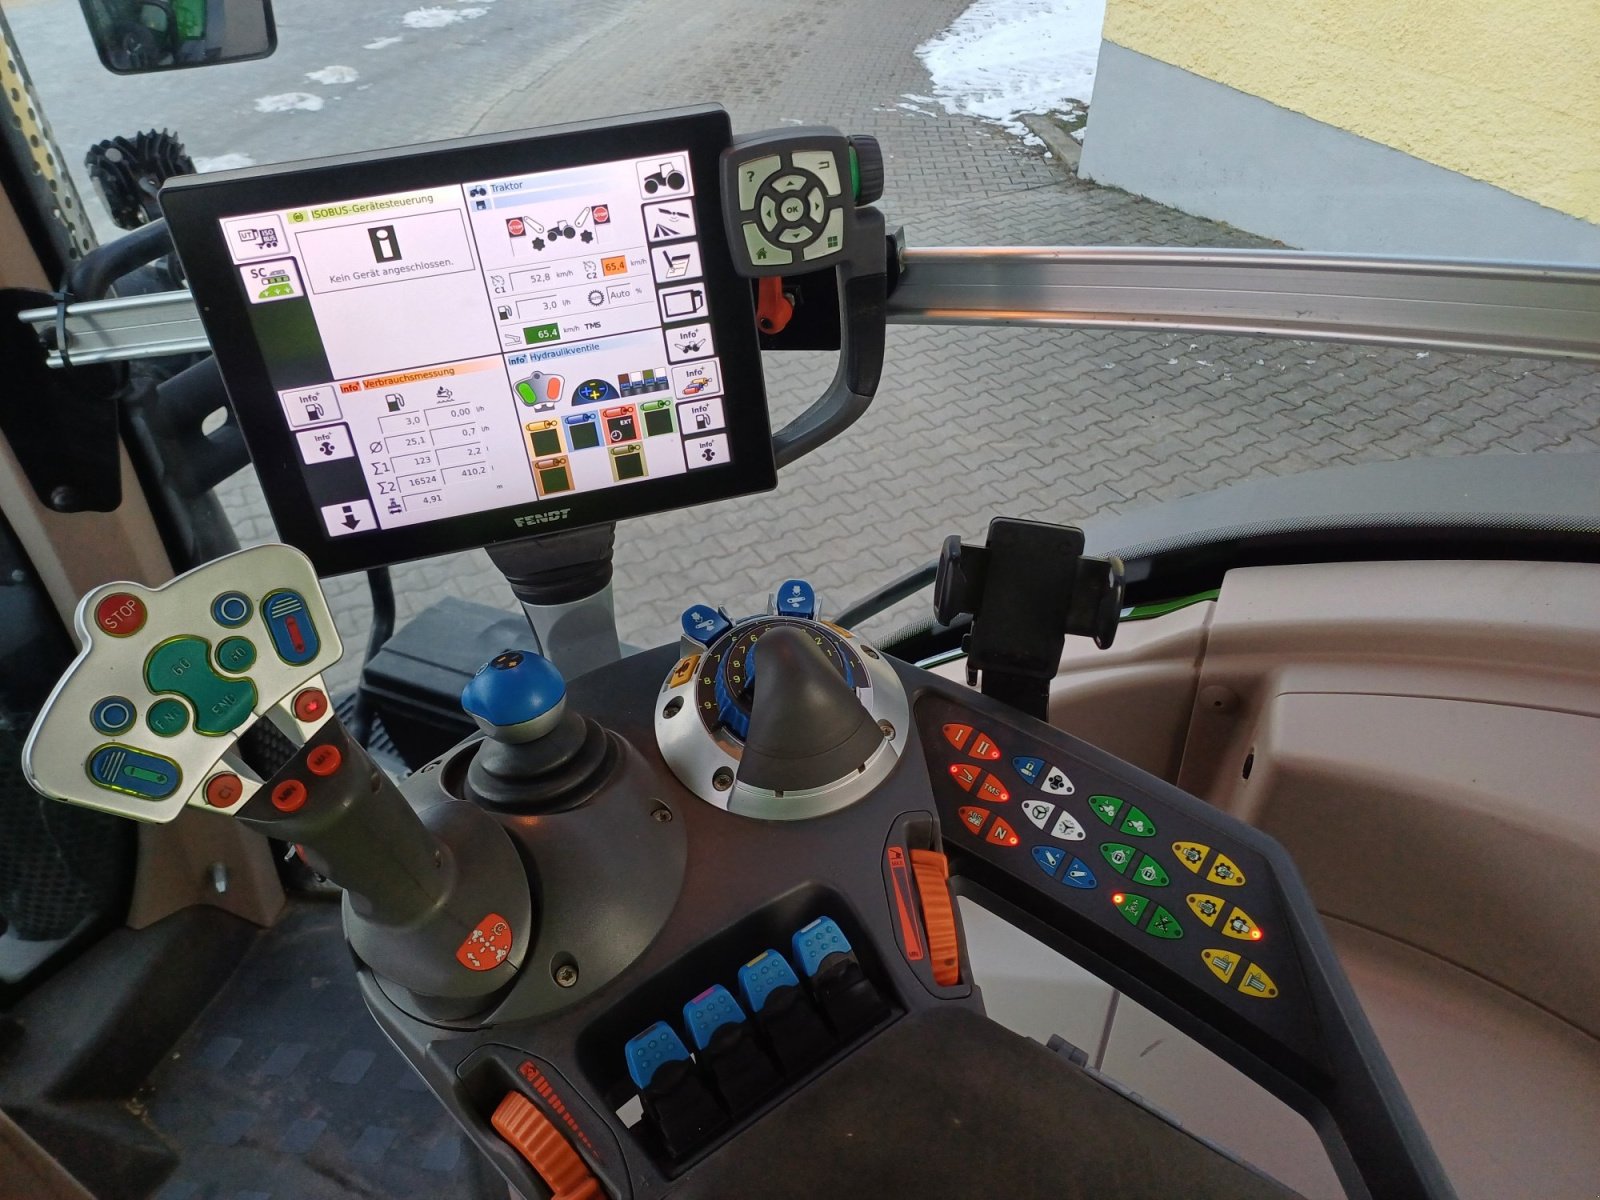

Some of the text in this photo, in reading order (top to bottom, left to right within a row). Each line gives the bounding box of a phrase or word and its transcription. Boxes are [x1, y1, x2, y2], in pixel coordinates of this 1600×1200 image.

[491, 181, 523, 193] Traktor
[311, 194, 434, 219] ISOBUS-Gerätesteuerung
[786, 205, 799, 215] OK
[241, 231, 252, 239] UT
[329, 259, 454, 284] Kein Gerät angeschlossen.
[605, 257, 648, 272] 65,4 km/h
[250, 267, 267, 279] SC
[530, 269, 574, 284] 52,8 km/h
[586, 272, 598, 280] C2
[610, 290, 631, 300] Auto
[542, 300, 557, 311] 3,0
[538, 321, 602, 339] 65,4 km/h TMS
[529, 343, 600, 363] Hydraulikventile
[362, 367, 456, 390] Verbrauchsmessung
[405, 416, 421, 426] 3,0
[451, 407, 471, 418] 0,00
[405, 436, 426, 447] 25,1
[462, 427, 476, 438] 0,7
[414, 456, 431, 467] 123
[467, 447, 482, 458] 2,2
[409, 475, 437, 487] 16524
[461, 466, 487, 477] 410,2
[423, 494, 443, 505] 4,91
[513, 508, 571, 528] FENDT
[104, 599, 137, 629] STOP
[750, 634, 758, 642] 6
[815, 637, 823, 645] 2
[739, 645, 746, 654] 7
[714, 654, 721, 663] 7
[733, 660, 741, 668] 8
[171, 658, 192, 676] GO
[703, 677, 712, 685] 8
[704, 701, 712, 710] 9
[983, 783, 1001, 797] TMS
[994, 826, 1007, 840] N
